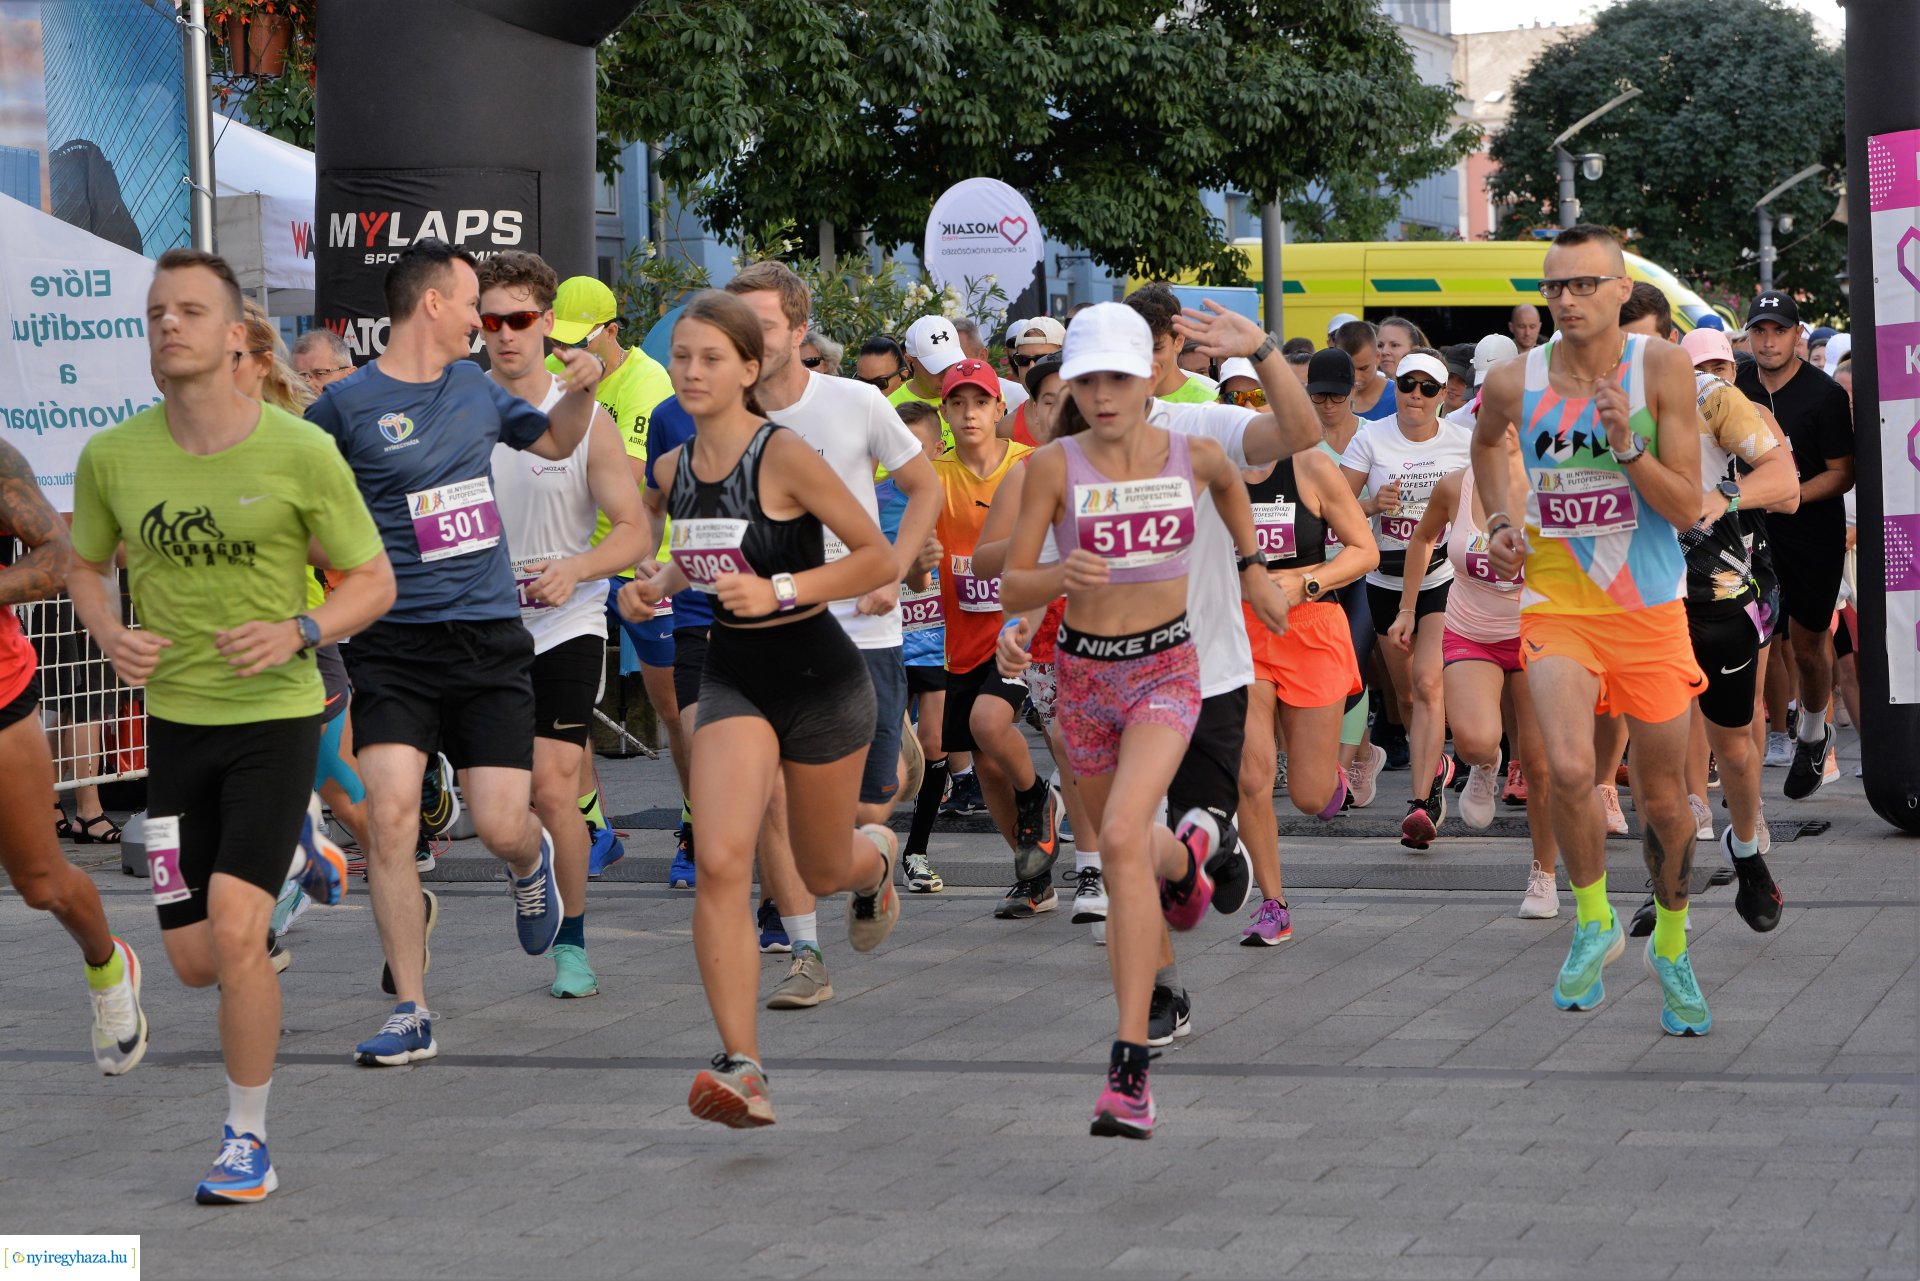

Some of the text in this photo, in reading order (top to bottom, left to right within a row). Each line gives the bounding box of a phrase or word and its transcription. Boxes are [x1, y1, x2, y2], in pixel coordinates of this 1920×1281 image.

[329, 210, 523, 248] MYLAPS
[1549, 494, 1622, 523] 5072
[438, 508, 485, 542] 501
[1093, 515, 1182, 552] 5142
[1389, 521, 1417, 538] 50
[173, 543, 256, 556] DRAGON
[1255, 528, 1284, 550] 05
[901, 600, 941, 623] 082
[1076, 637, 1146, 657] NIKE
